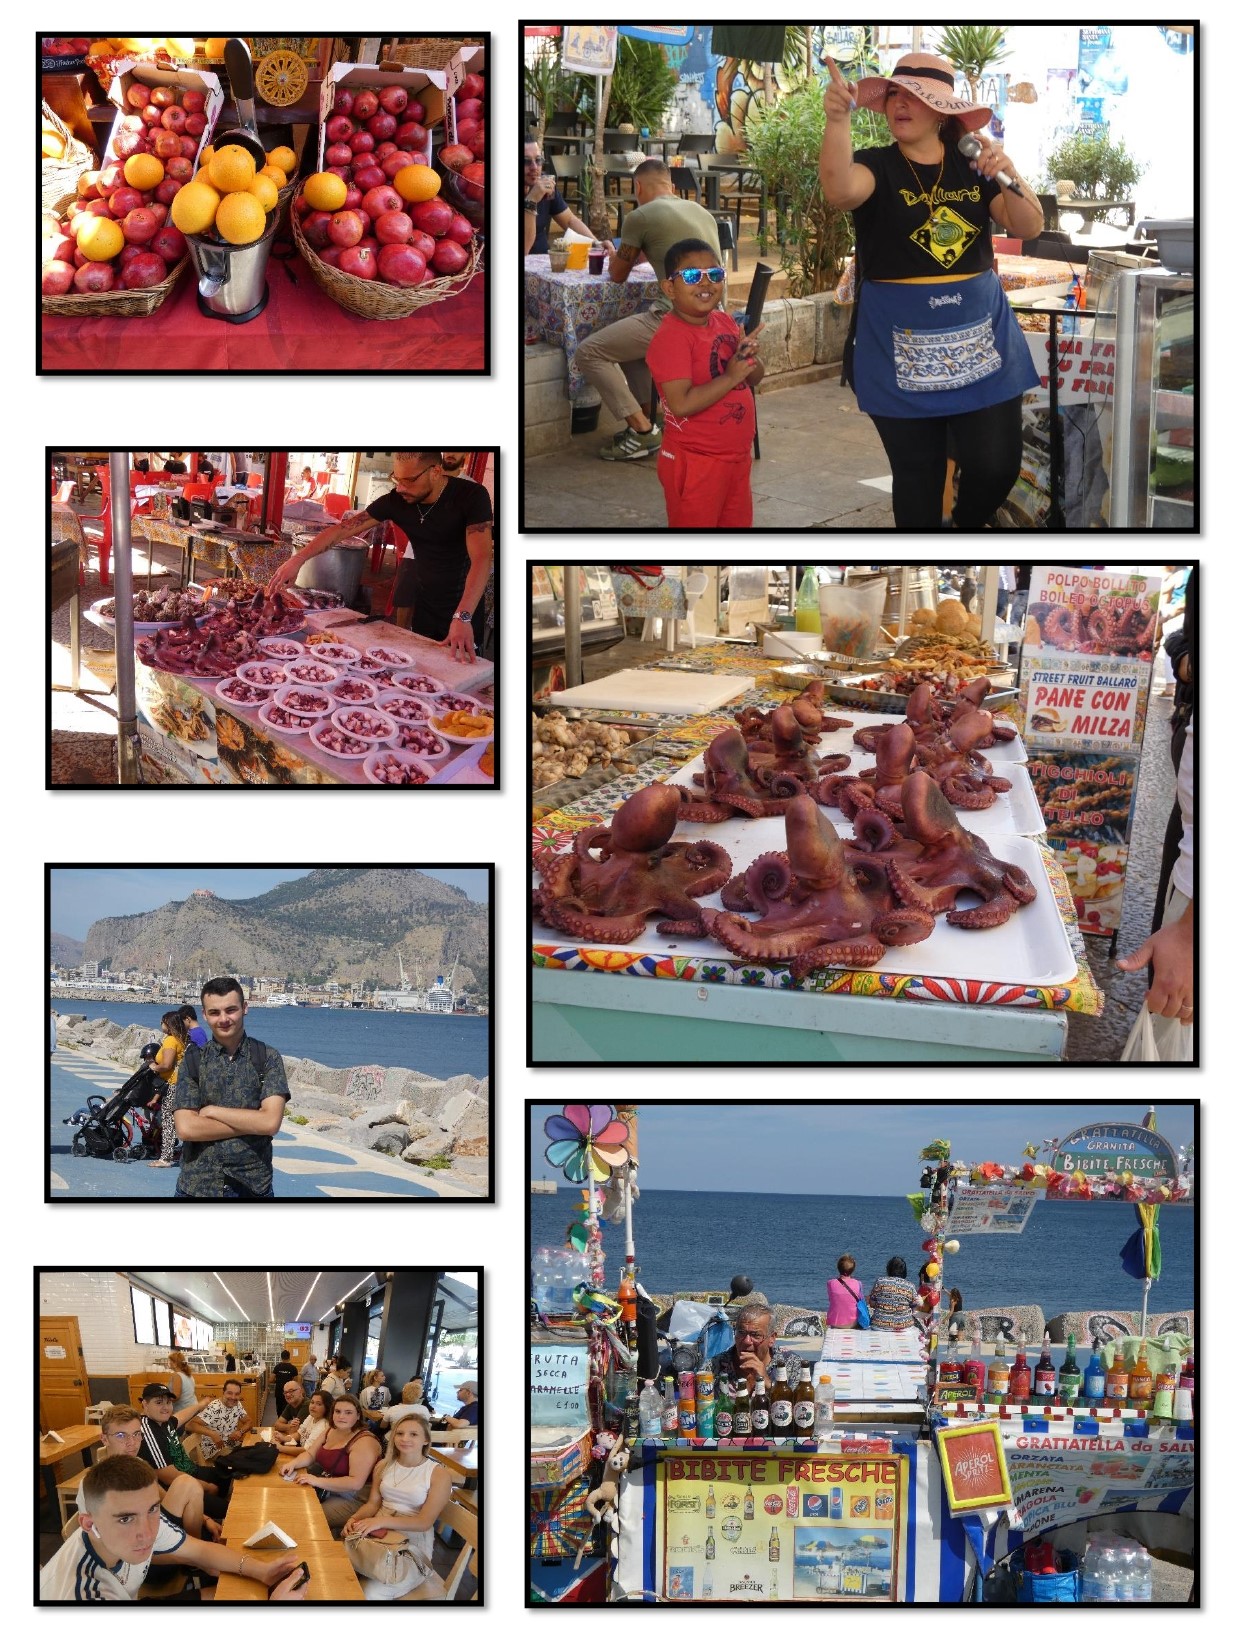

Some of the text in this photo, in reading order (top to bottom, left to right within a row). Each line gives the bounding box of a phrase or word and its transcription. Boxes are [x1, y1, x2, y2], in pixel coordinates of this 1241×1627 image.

[1047, 573, 1147, 593] POLPO BOLLITO
[1040, 590, 1151, 611] BOILED OCTOPUS
[1032, 672, 1066, 684] STREET
[1067, 674, 1096, 686] FRUIT
[1035, 687, 1131, 712] PANE CON
[1071, 715, 1131, 738] MILZA
[1028, 762, 1127, 785] TIGGHIOLI
[1059, 788, 1078, 800] DI
[1041, 807, 1105, 826] ITELLO
[1086, 1140, 1136, 1151] GRANITA
[1116, 1156, 1168, 1170] FRESCHE
[535, 1369, 567, 1379] SECCA
[940, 1389, 973, 1399] APEROL
[1016, 1436, 1124, 1452] GRATTATELLA
[1131, 1441, 1153, 1452] da
[955, 1453, 994, 1476] APEROL
[1010, 1454, 1064, 1462] ORZATA
[669, 1459, 897, 1484] BIBITE FRESCHE
[961, 1465, 989, 1481] SPRITZ
[1009, 1462, 1084, 1471] ARANCIATA
[1009, 1470, 1050, 1481] MENTA
[1053, 1501, 1077, 1510] BLU
[729, 1583, 764, 1594] BREEZER
